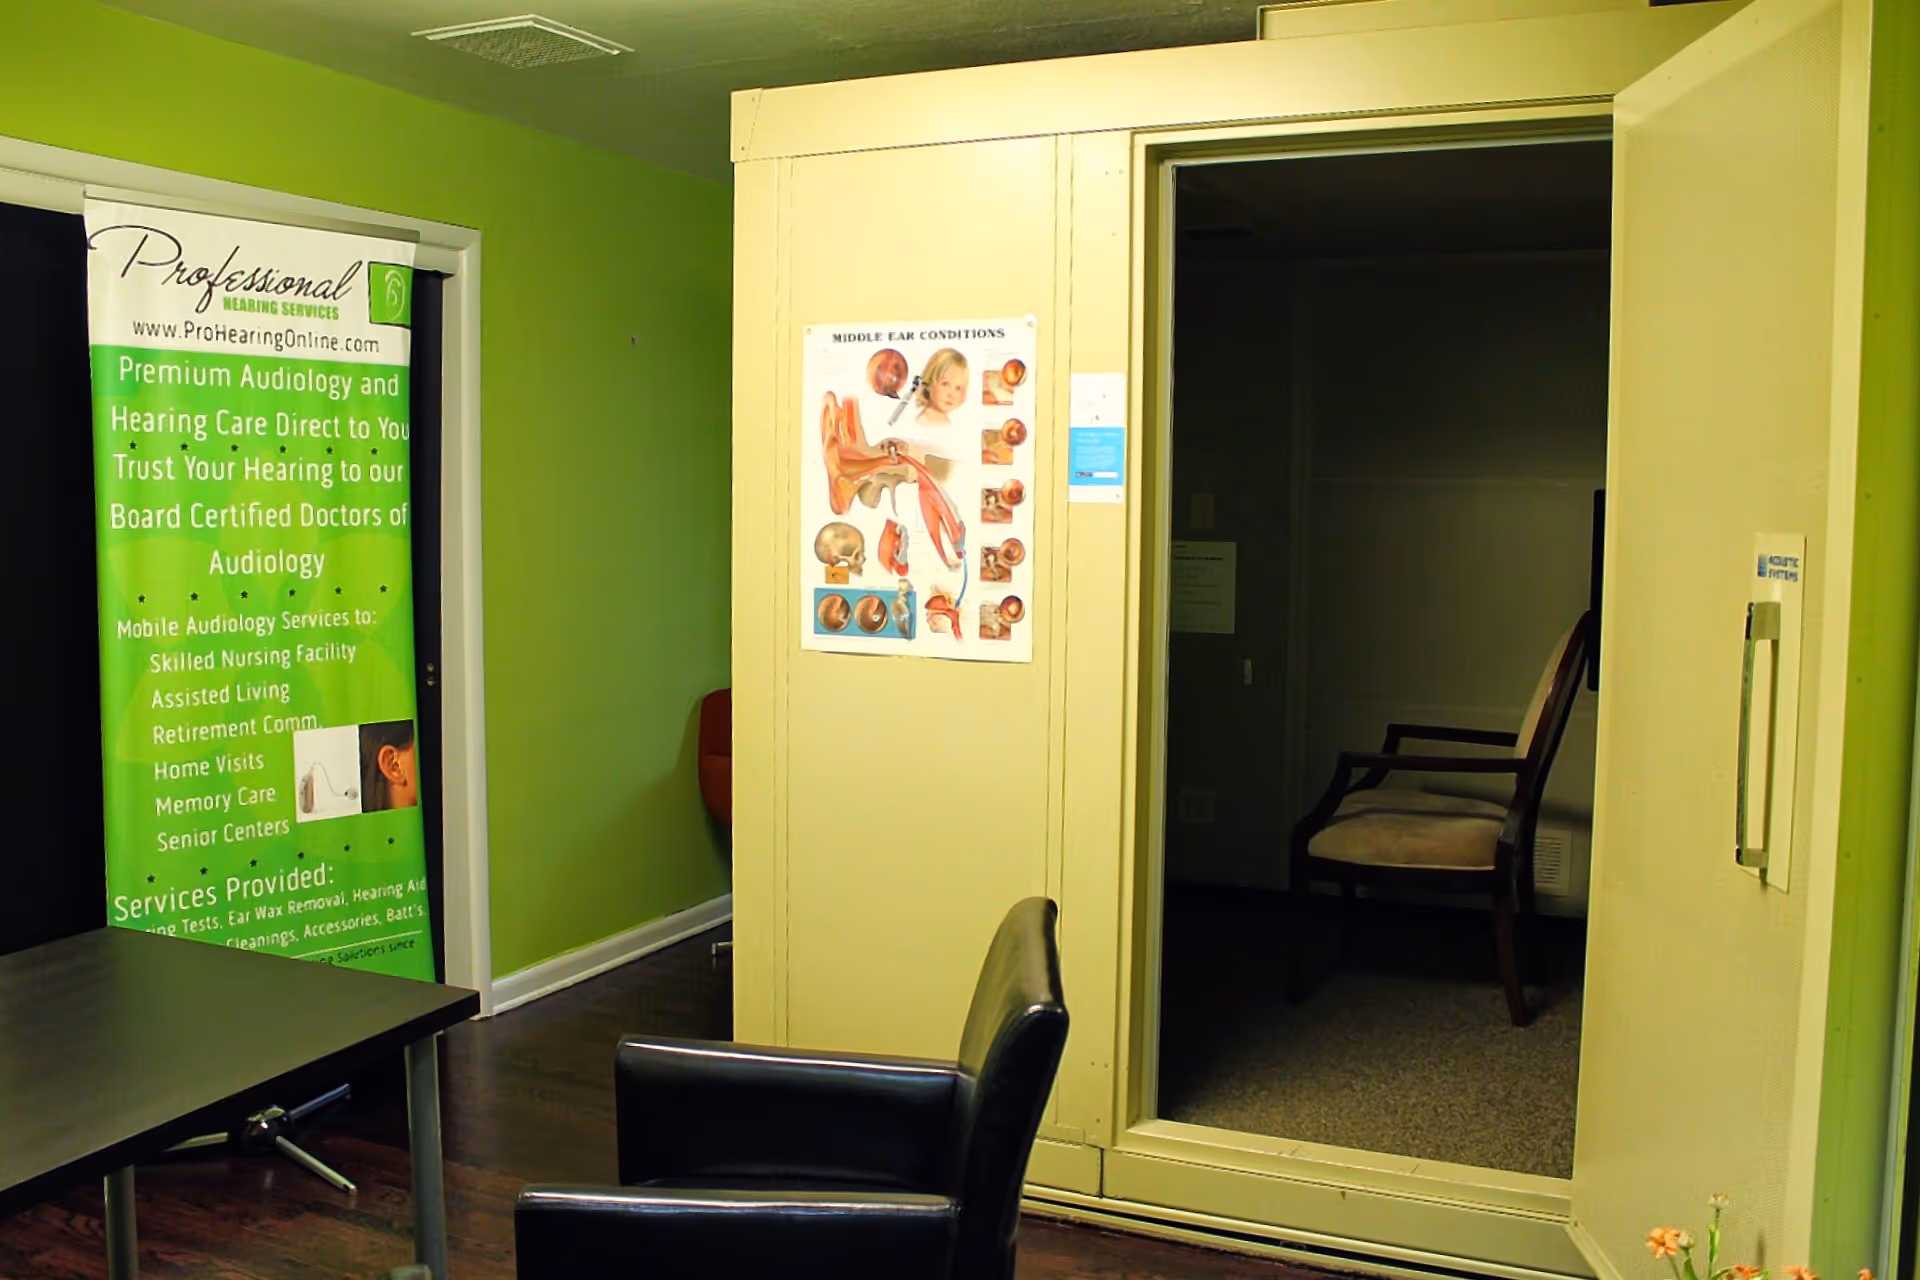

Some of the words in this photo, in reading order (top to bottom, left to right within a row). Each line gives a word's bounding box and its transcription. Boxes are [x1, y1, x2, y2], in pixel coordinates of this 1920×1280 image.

[87, 224, 363, 314] Professional
[223, 296, 278, 315] HEARING
[281, 300, 339, 320] SERVICES
[132, 320, 380, 353] www.ProHearingOnline.com
[832, 332, 883, 343] MIDDLE
[888, 331, 915, 342] EAR
[919, 328, 1006, 341] CONDITIONS
[119, 355, 231, 387] Premium
[240, 363, 352, 400] Audiology
[360, 373, 399, 396] and
[111, 406, 207, 441] Hearing
[216, 409, 267, 436] Care
[276, 412, 340, 440] Direct
[349, 419, 371, 440] to
[378, 417, 410, 441] You
[113, 453, 174, 481] Trust
[184, 455, 235, 481] Your
[244, 457, 333, 488] Hearing
[341, 459, 362, 482] to
[369, 463, 404, 483] our
[111, 503, 181, 530] Board
[190, 502, 292, 529] Certified
[300, 503, 382, 528] Doctors
[389, 502, 408, 526] of
[209, 550, 325, 580] Audiology
[117, 617, 178, 639] Mobile
[186, 613, 276, 638] Audiology
[281, 609, 350, 630] Services
[355, 609, 377, 626] to:
[150, 649, 215, 673] Skilled
[222, 647, 291, 669] Nursing
[296, 642, 357, 664] Facility
[152, 686, 230, 709] Assisted
[237, 682, 290, 704] Living
[153, 717, 257, 744] Retirement
[263, 714, 322, 733] Comm.
[154, 755, 210, 780] Home
[215, 752, 264, 773] Visits
[156, 791, 232, 816] Memory
[238, 786, 276, 806] Care
[158, 827, 217, 852] Senior
[224, 819, 290, 842] Centers
[114, 884, 217, 922] Services
[226, 863, 335, 901] Provided:
[228, 910, 250, 926] Ear
[255, 905, 283, 920] Wax
[353, 883, 403, 902] Hearing
